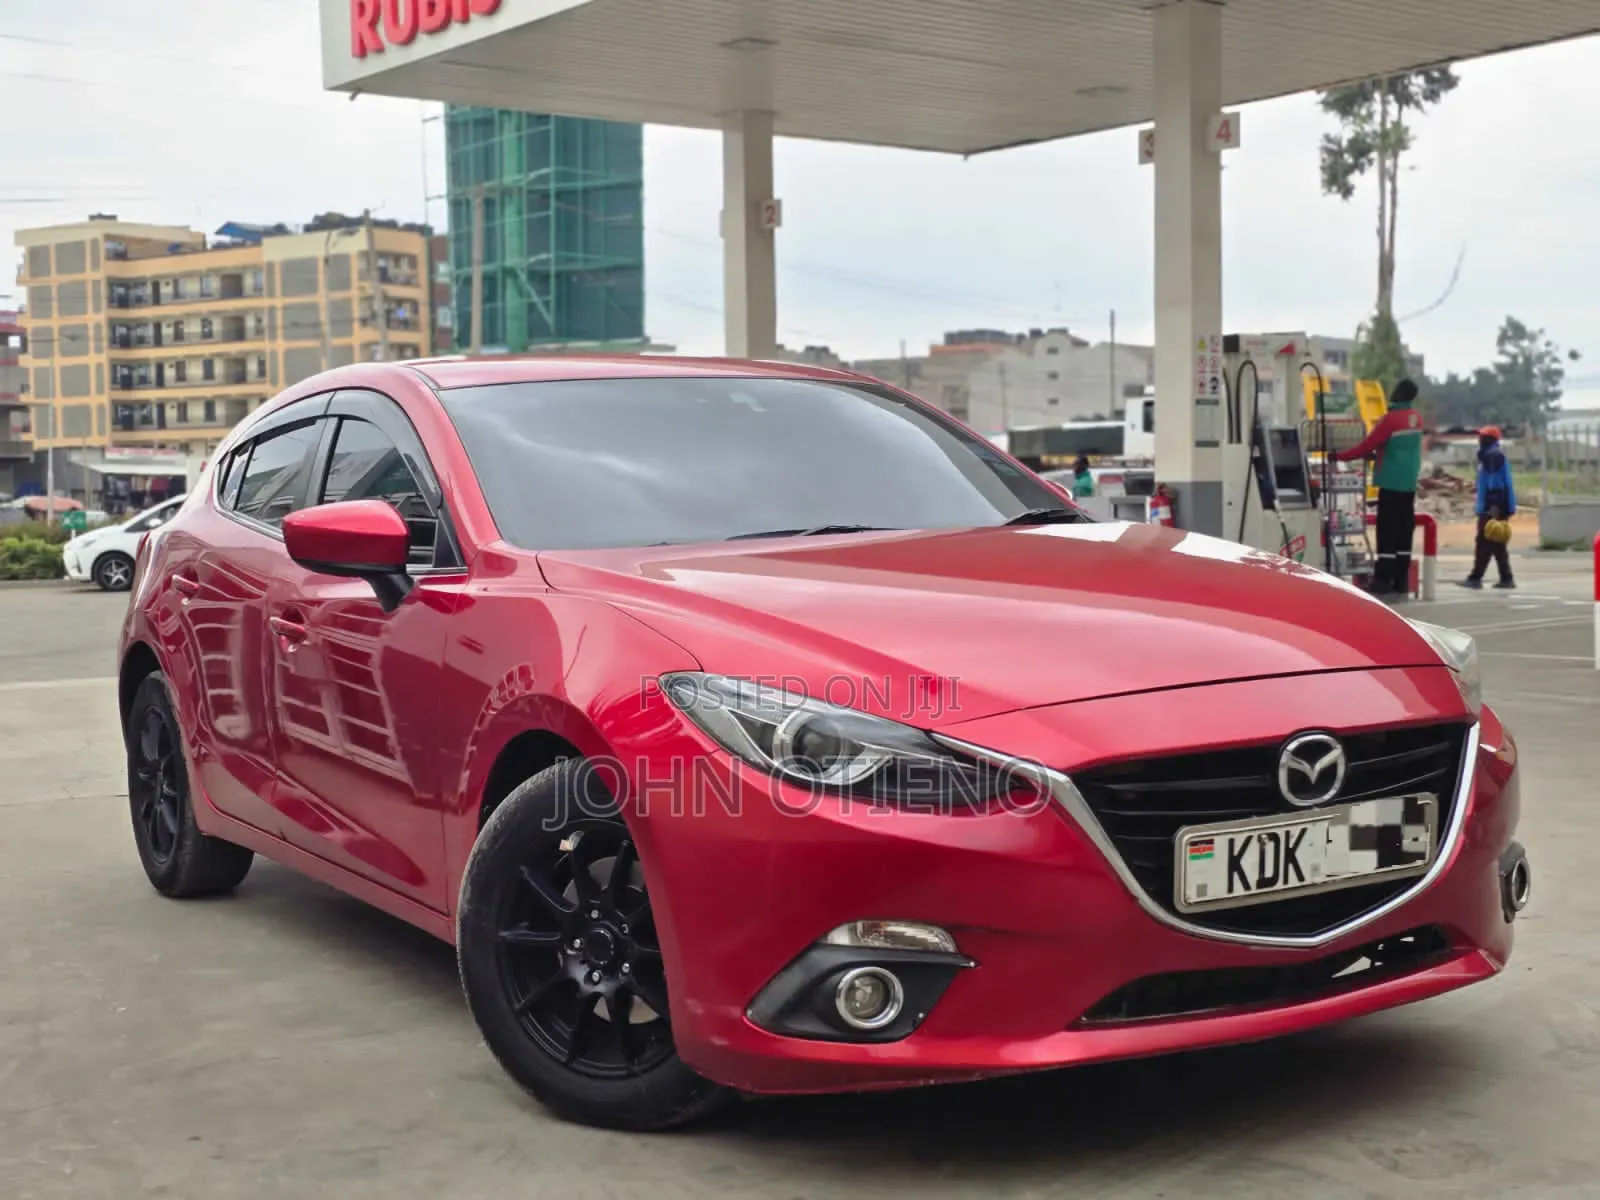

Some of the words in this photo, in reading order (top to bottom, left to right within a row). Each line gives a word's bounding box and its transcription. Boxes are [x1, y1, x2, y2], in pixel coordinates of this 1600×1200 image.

[350, 0, 502, 59] RUB
[1214, 118, 1232, 144] 4
[765, 204, 777, 225] 2
[1226, 827, 1308, 894] KDK
